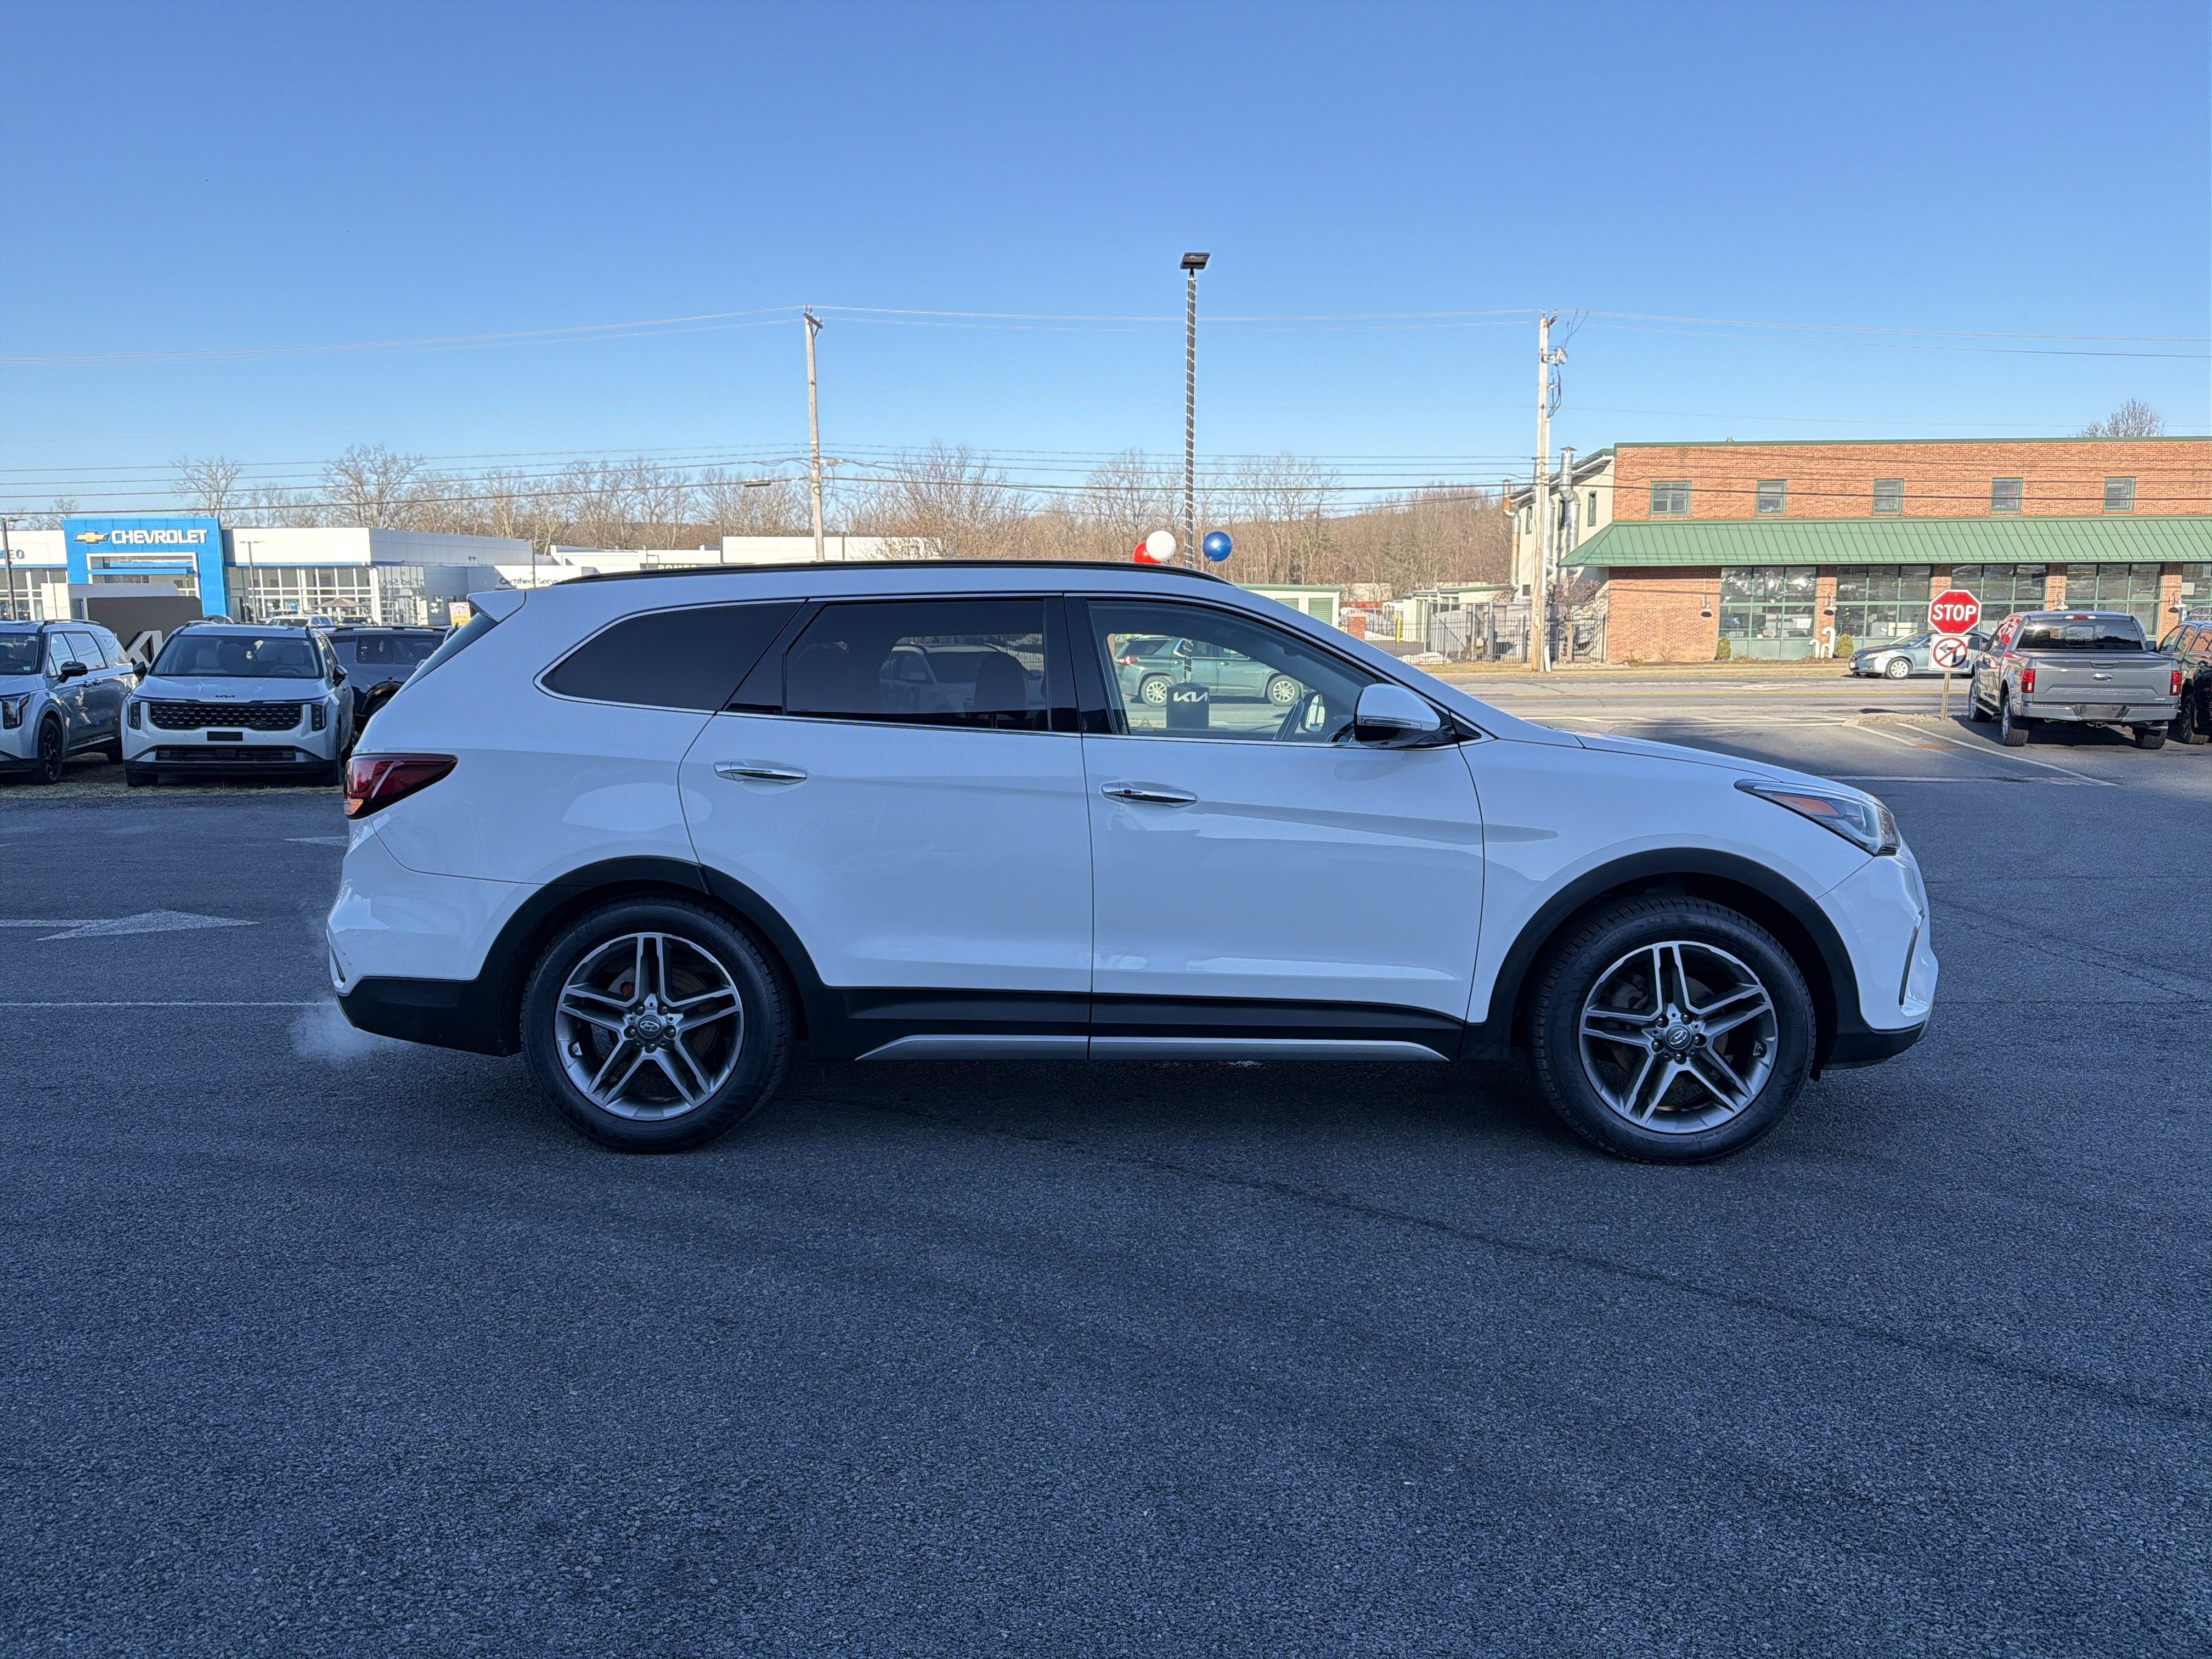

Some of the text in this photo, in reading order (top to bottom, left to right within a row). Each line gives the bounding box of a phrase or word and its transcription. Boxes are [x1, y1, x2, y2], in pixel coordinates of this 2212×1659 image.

[111, 529, 208, 544] CHEVROLET
[1932, 603, 1977, 622] STOP
[1173, 691, 1208, 702] KIA
